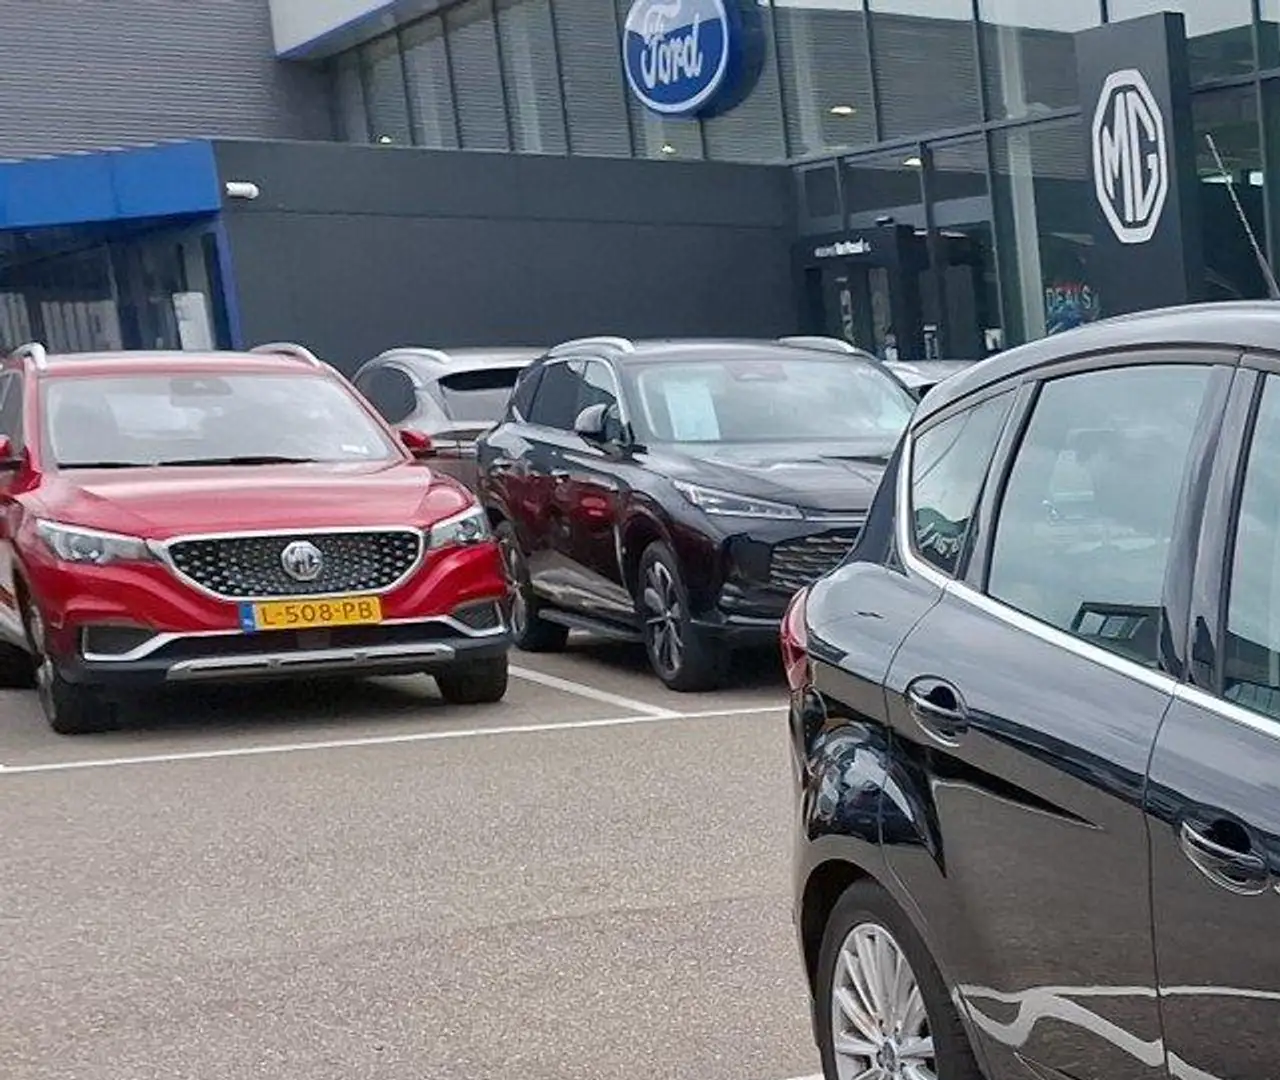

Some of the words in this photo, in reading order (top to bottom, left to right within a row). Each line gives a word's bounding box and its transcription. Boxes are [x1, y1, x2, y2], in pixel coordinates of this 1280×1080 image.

[640, 1, 703, 89] Ford
[1101, 89, 1159, 223] MG
[1045, 284, 1092, 312] DEALS
[261, 601, 373, 625] L-508-PB
